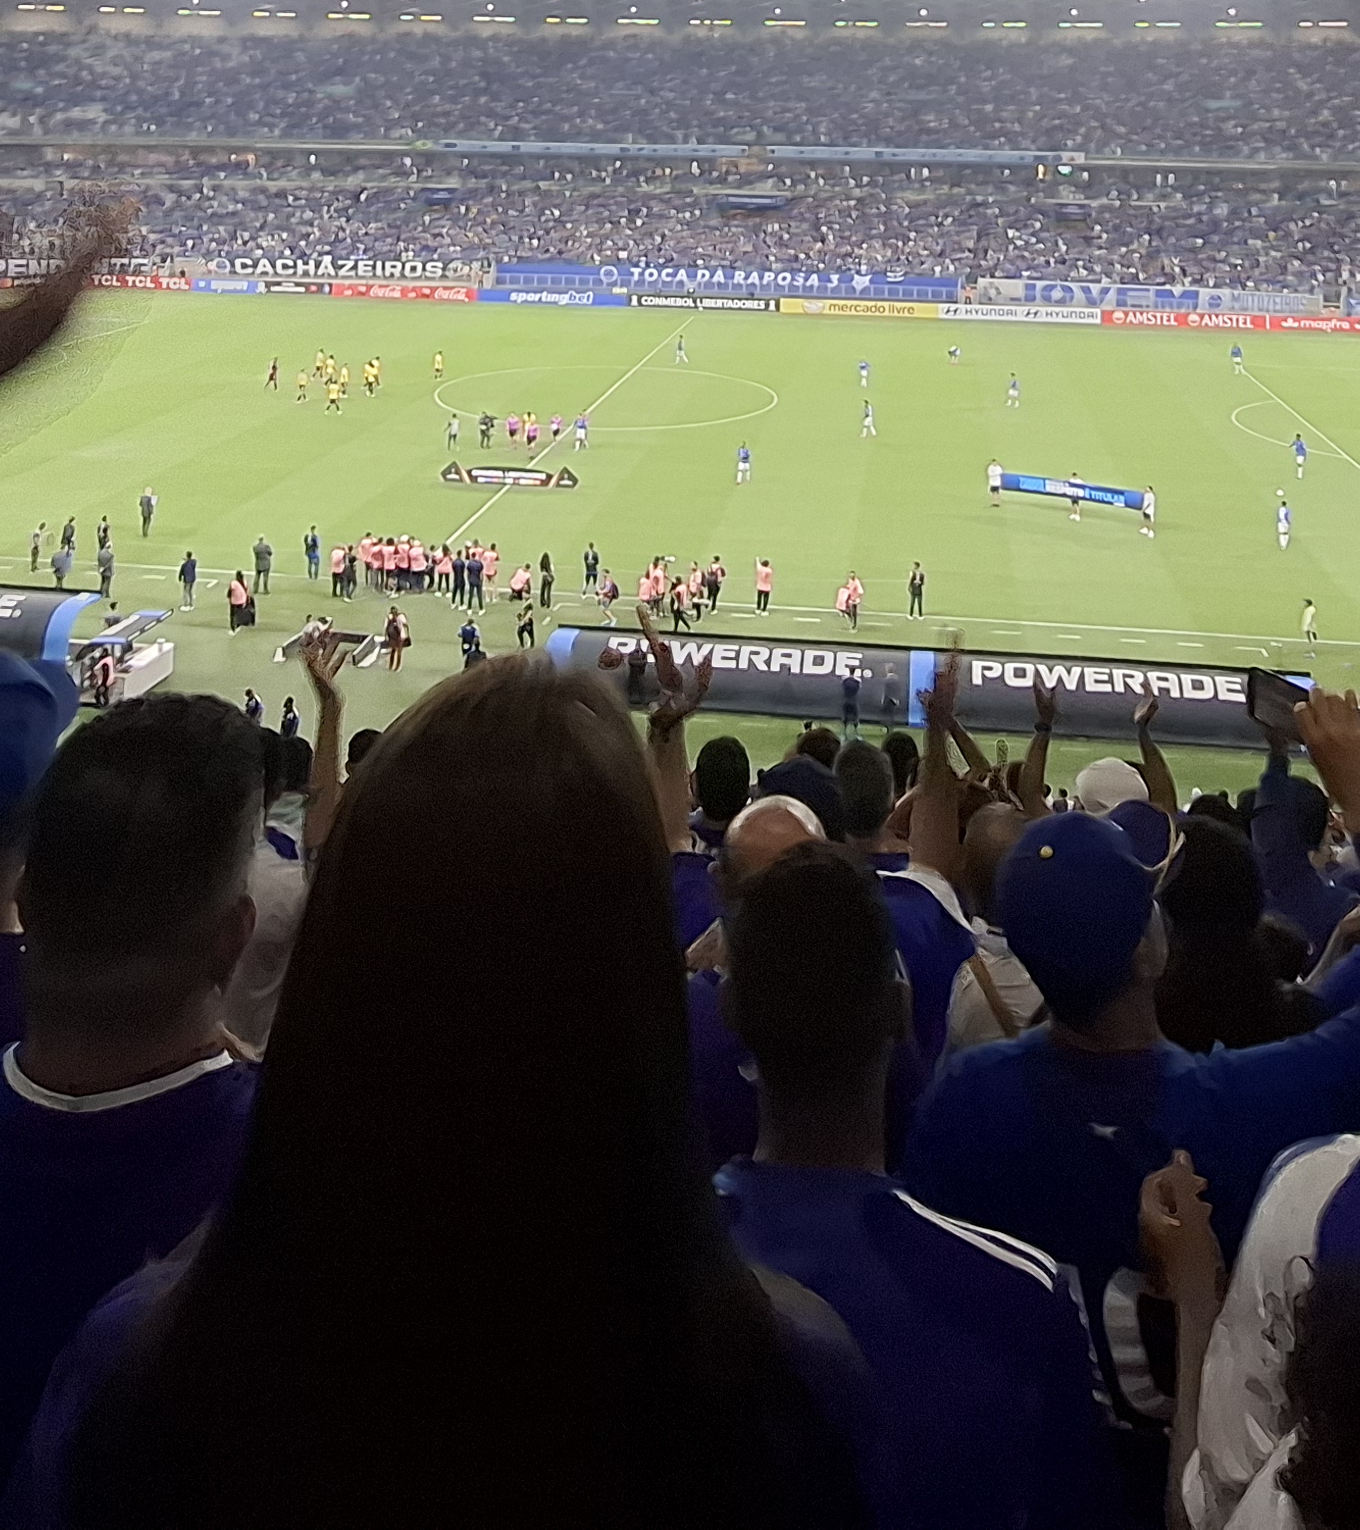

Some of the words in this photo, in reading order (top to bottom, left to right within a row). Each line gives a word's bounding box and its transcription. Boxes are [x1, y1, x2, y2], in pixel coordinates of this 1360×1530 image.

[234, 257, 443, 278] CACHAZEIROS
[91, 274, 121, 286] TCL
[125, 275, 155, 288] TCL
[158, 277, 190, 290] TCL
[630, 267, 688, 283] TOCA
[697, 268, 725, 284] DA
[733, 270, 820, 287] RAPOSA
[510, 290, 594, 306] sportingbet
[641, 296, 695, 308] CONMEBOL
[697, 297, 766, 311] LIBERTADORES
[828, 301, 886, 315] mercado
[888, 302, 916, 316] livre
[965, 307, 1018, 318] HYUNDAI
[1045, 309, 1099, 320] HYUNDAI
[1124, 311, 1178, 327] AMSTEL
[1201, 313, 1254, 329] AMSTEL
[1300, 318, 1351, 331] mapfre
[608, 636, 872, 678] PWERADE.
[972, 659, 1247, 704] POWERADE
